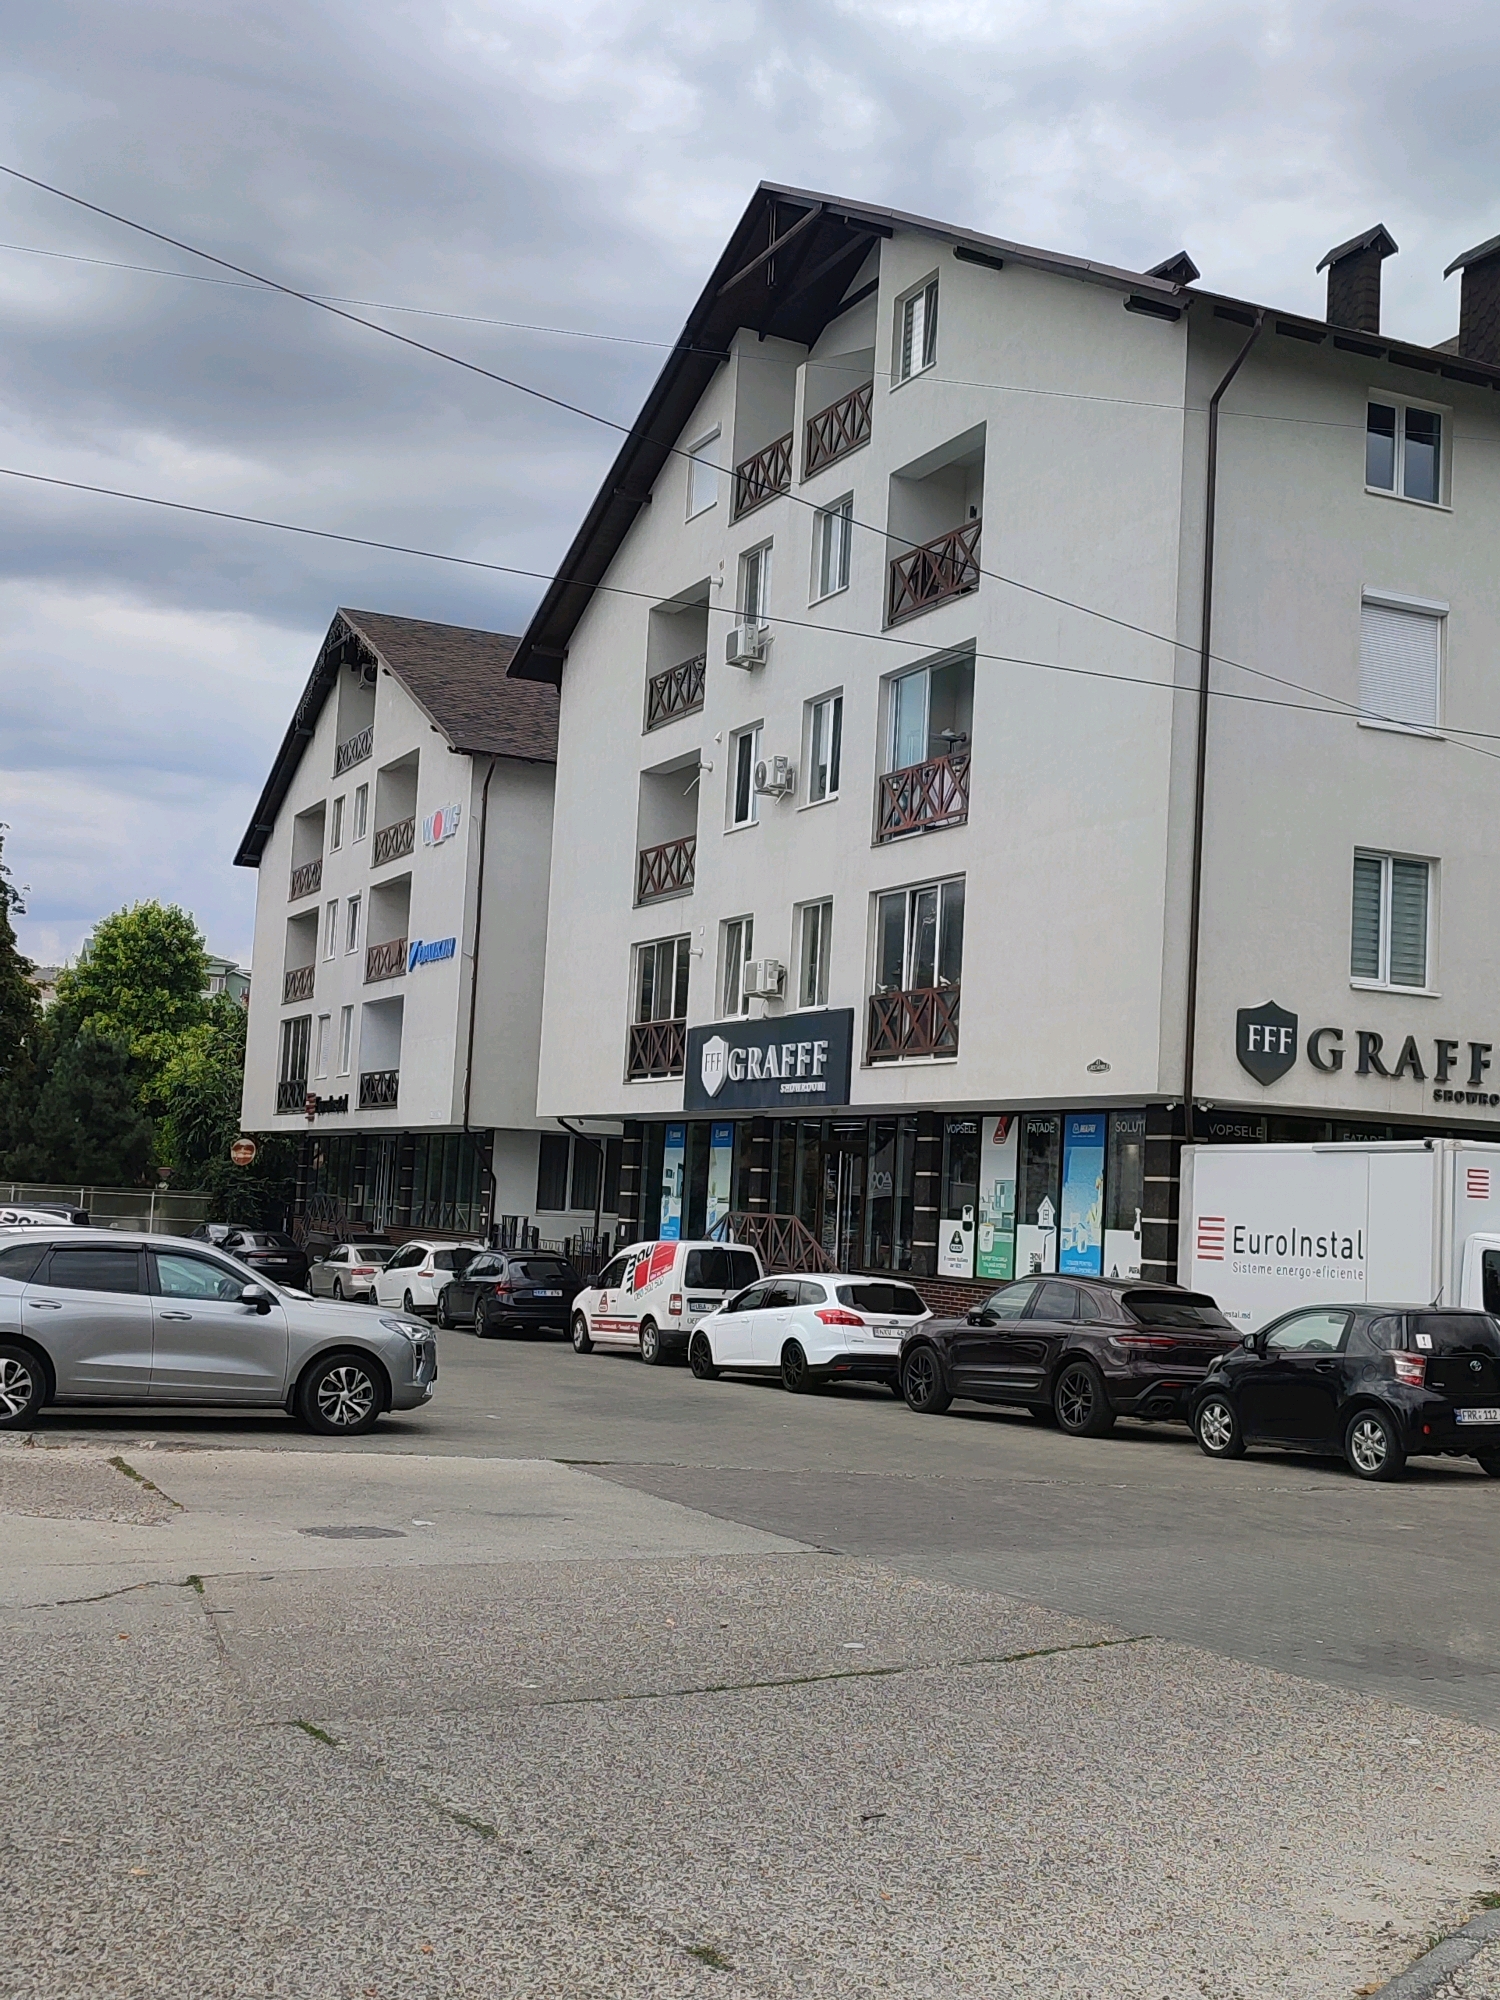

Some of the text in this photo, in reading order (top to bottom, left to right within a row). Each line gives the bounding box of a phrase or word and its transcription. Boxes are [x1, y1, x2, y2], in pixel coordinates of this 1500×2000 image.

[1247, 1024, 1293, 1055] FFF
[704, 1053, 722, 1073] FFF
[727, 1040, 829, 1082] GRAFFF
[1307, 1027, 1493, 1085] GRAFF
[946, 1122, 977, 1134] VOPSELE
[1209, 1123, 1264, 1139] VOPSELE
[1233, 1225, 1364, 1260] EuroInstal
[1232, 1261, 1364, 1280] Sisteme energo-eficiente
[1461, 1410, 1498, 1420] FRR 112
